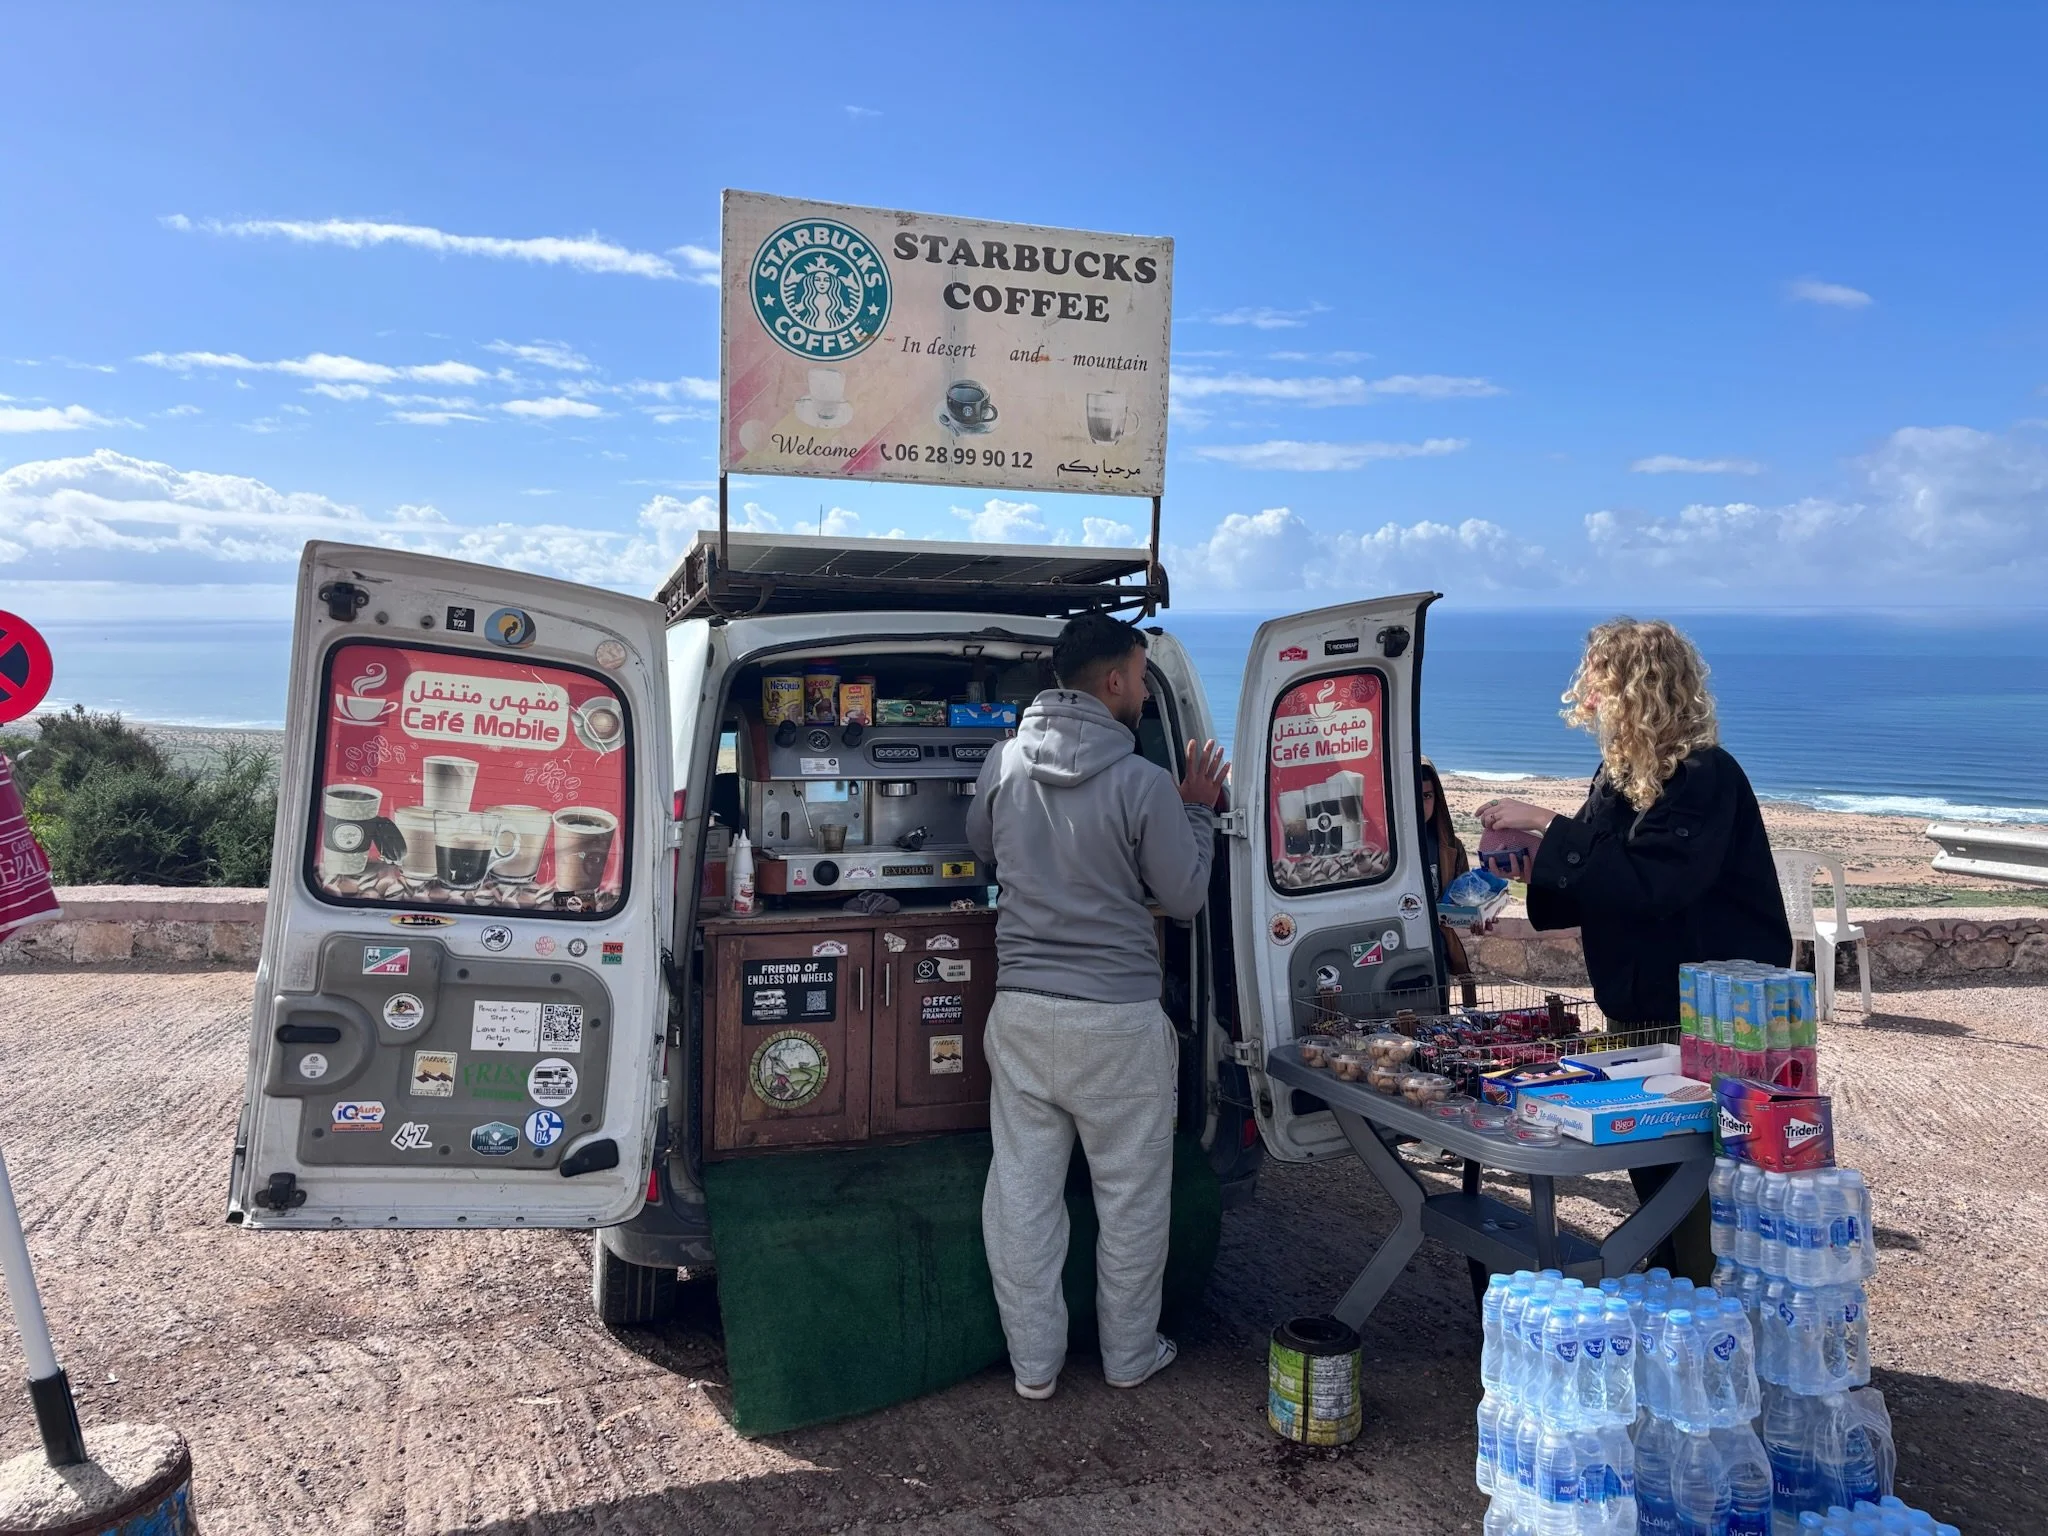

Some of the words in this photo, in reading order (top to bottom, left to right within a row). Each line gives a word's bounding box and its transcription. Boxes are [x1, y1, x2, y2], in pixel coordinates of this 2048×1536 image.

[759, 226, 883, 289] STARBUCKS
[893, 232, 1157, 284] STARBUCKS
[943, 282, 1110, 323] COFFEE
[774, 315, 869, 354] COFFEE
[901, 335, 921, 353] In
[926, 336, 977, 358] desert
[1009, 345, 1045, 363] and
[1073, 354, 1148, 371] mountain
[771, 433, 858, 459] Welcome
[895, 443, 919, 461] 06
[925, 446, 948, 463] 28
[953, 447, 976, 465] 99
[982, 450, 1005, 467] 90
[1011, 451, 1033, 468] 12
[410, 681, 482, 704] متنقل
[404, 707, 465, 733] Café
[474, 714, 560, 742] Mobile
[1274, 721, 1318, 741] متنقل
[1273, 743, 1309, 761] Café
[1316, 736, 1368, 756] Mobile
[748, 975, 784, 985] ENDLESS
[787, 974, 799, 983] ON
[801, 972, 833, 983] WHEELS
[762, 964, 800, 974] FRIEND
[805, 963, 819, 972] OF
[932, 996, 952, 1006] EFC
[537, 1112, 550, 1131] S
[1615, 1120, 1634, 1130] Bigor
[1640, 1108, 1712, 1128] Millefeuill
[1718, 1112, 1752, 1133] Trident
[1785, 1123, 1823, 1137] Trident
[536, 1131, 548, 1144] 04
